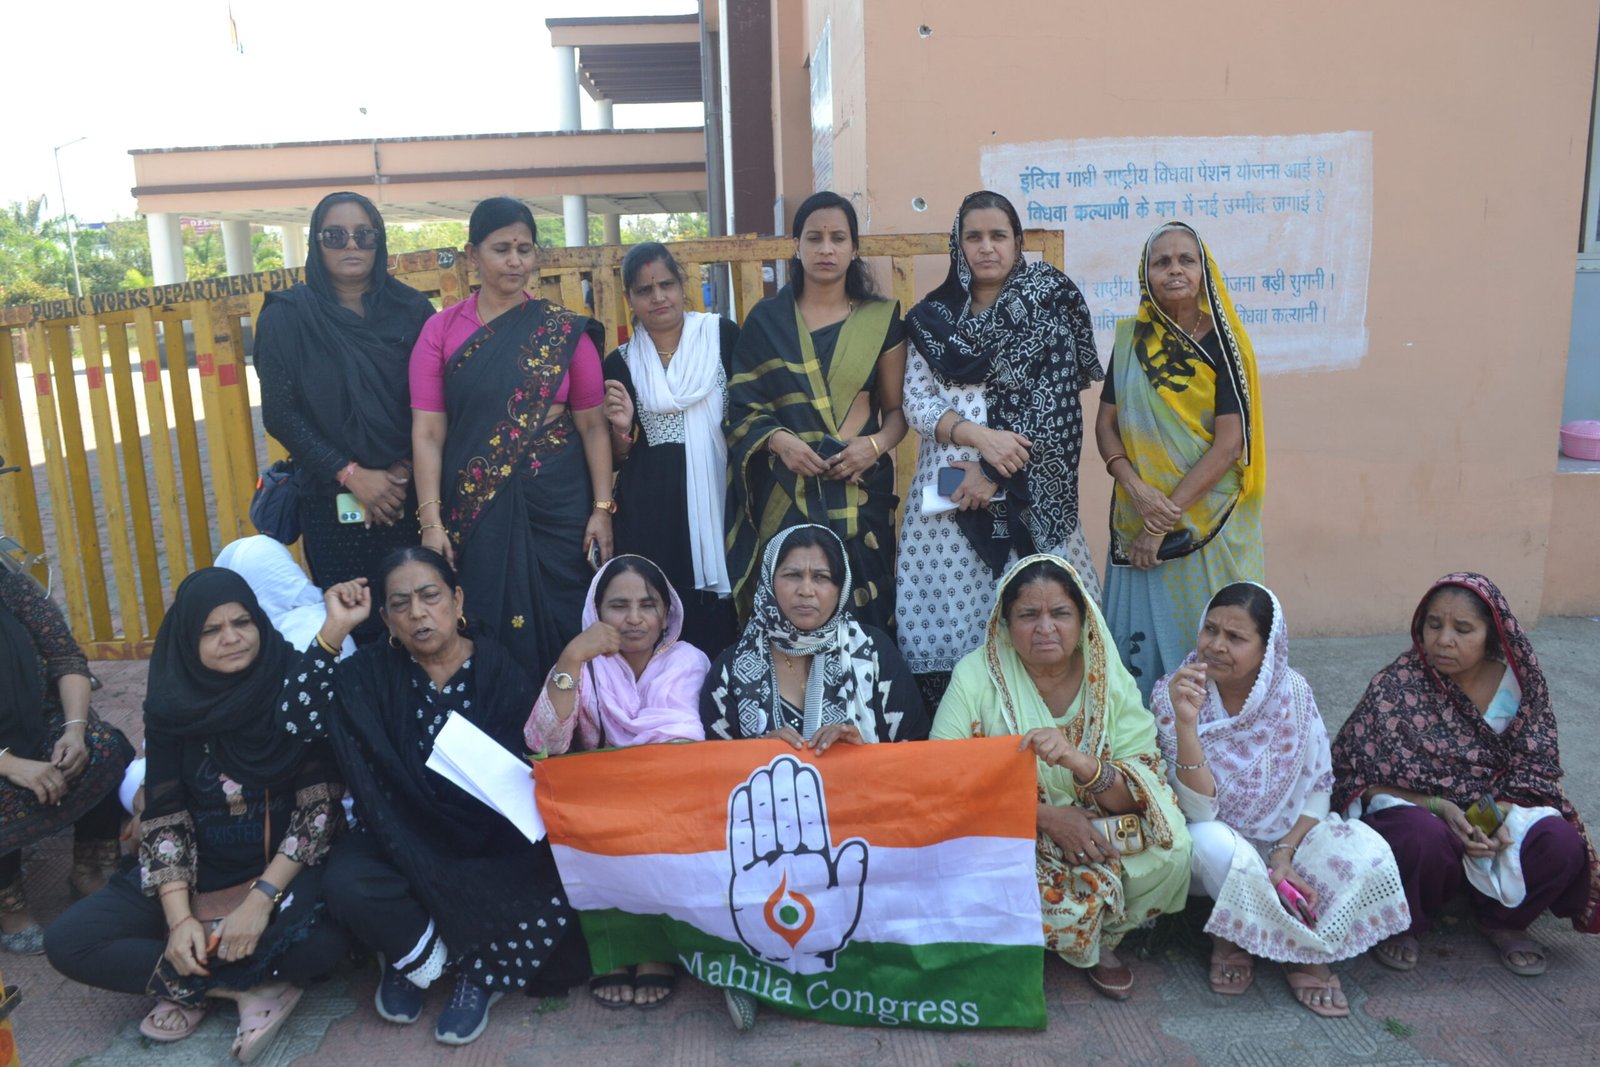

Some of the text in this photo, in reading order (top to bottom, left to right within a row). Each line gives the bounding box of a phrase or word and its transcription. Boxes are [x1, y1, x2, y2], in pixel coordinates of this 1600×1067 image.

[1019, 166, 1060, 195] इंदिरा
[1066, 164, 1096, 188] गांधी
[1103, 162, 1148, 189] राष्ट्रीय
[1154, 161, 1193, 184] विधवा
[1236, 158, 1280, 181] योजना
[1284, 156, 1312, 181] आई
[1027, 201, 1067, 222] विधवा
[1073, 196, 1129, 221] कल्याणी
[1136, 196, 1150, 218] के
[1154, 200, 1176, 217] मन
[1182, 193, 1194, 217] में
[31, 296, 87, 321] PUBLIC
[91, 288, 150, 314] WORKS
[153, 272, 264, 305] DEPARTMENT
[679, 951, 980, 1026] Mahila Congress
